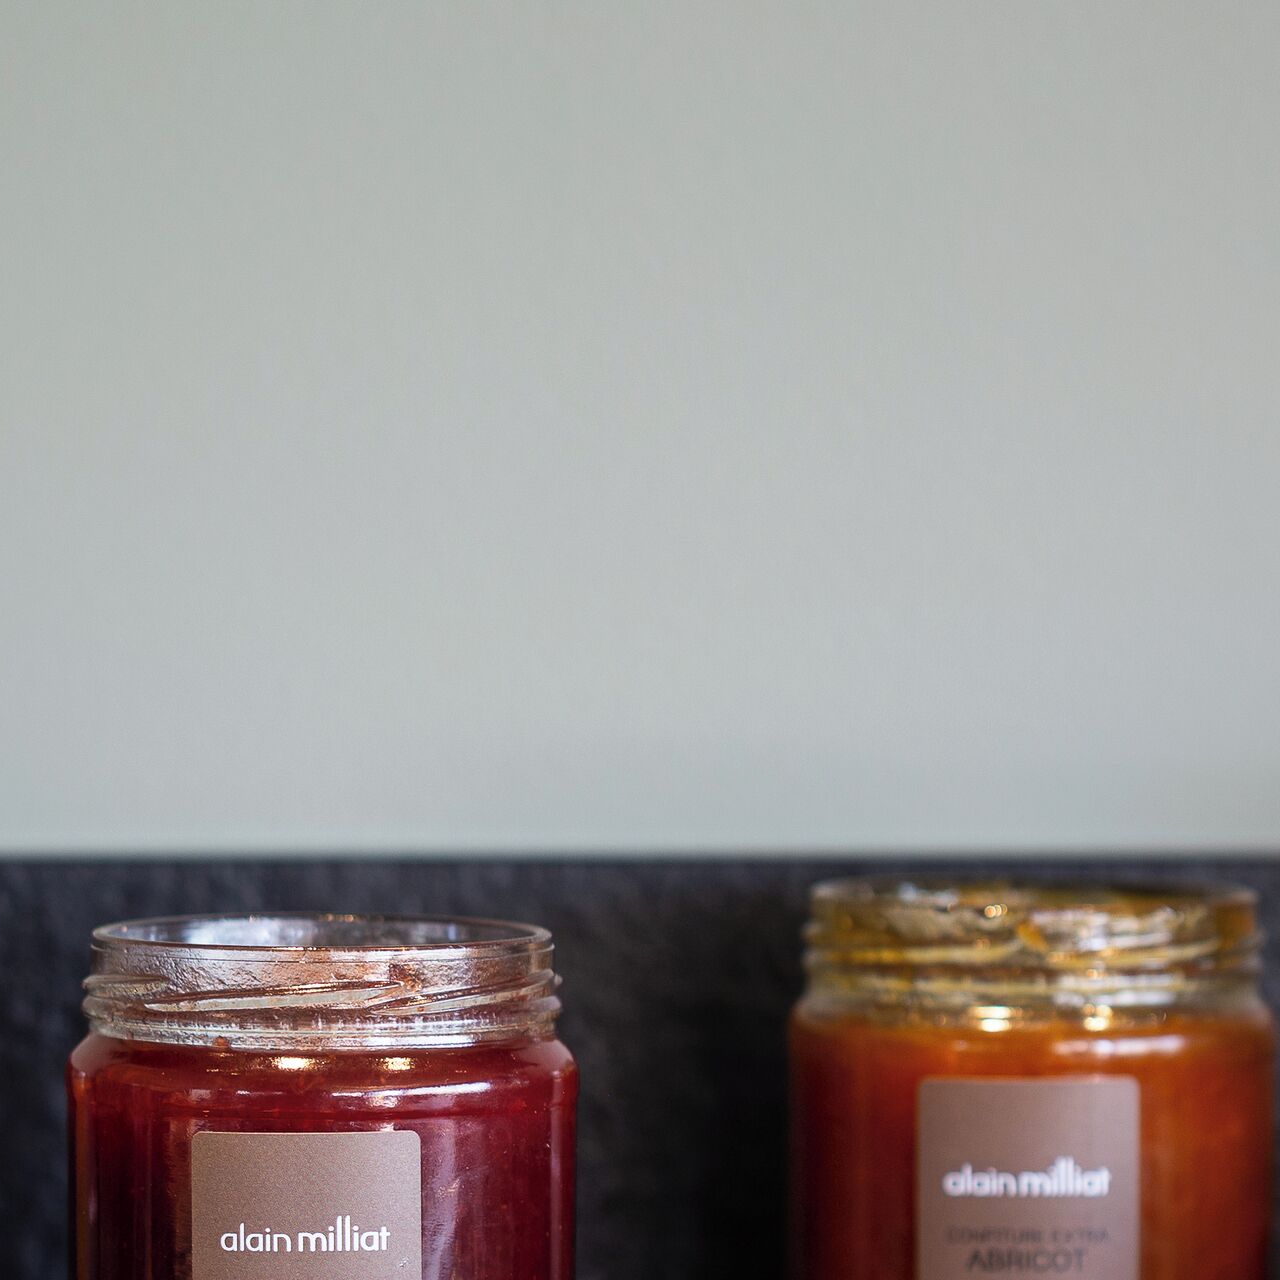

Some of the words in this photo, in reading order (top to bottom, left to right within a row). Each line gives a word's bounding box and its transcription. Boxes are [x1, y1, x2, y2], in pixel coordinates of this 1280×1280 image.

[942, 1162, 1017, 1197] alain
[1017, 1155, 1111, 1198] milliat
[220, 1222, 292, 1252] alain
[297, 1215, 390, 1252] milliat
[965, 1248, 1086, 1273] ABRICOT
